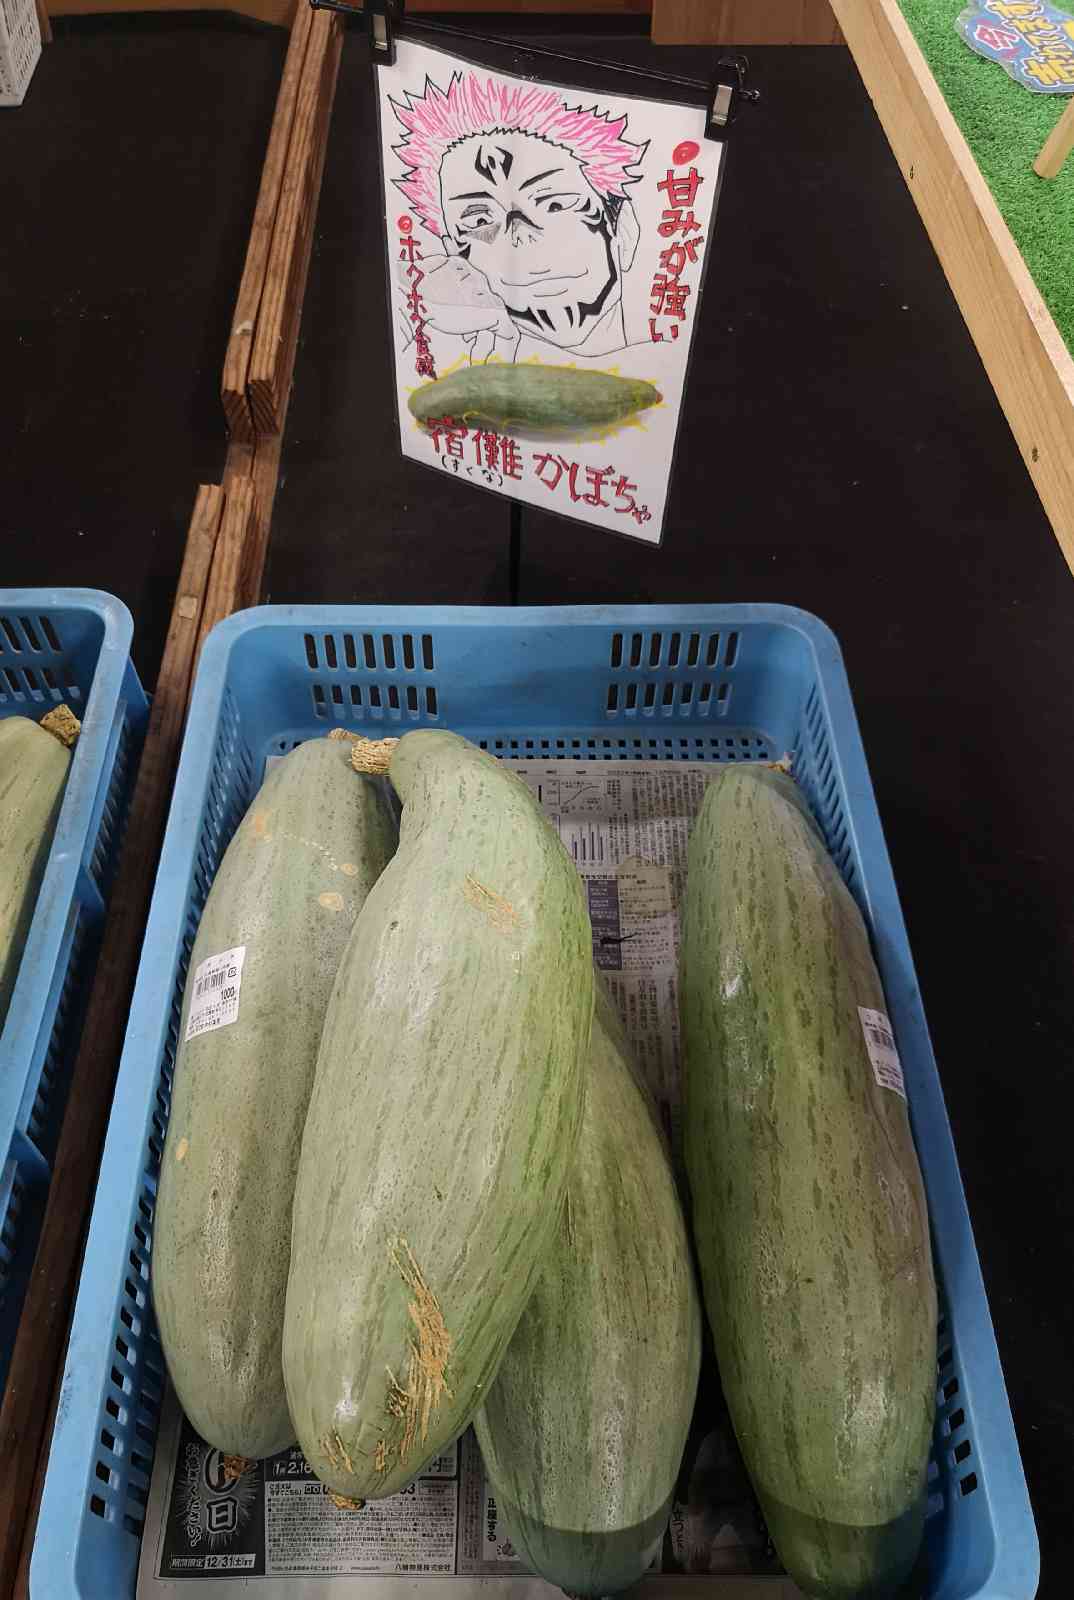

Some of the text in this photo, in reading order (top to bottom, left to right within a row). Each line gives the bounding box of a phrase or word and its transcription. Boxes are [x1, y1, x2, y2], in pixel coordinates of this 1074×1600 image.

[648, 167, 704, 342] 甘みが強い
